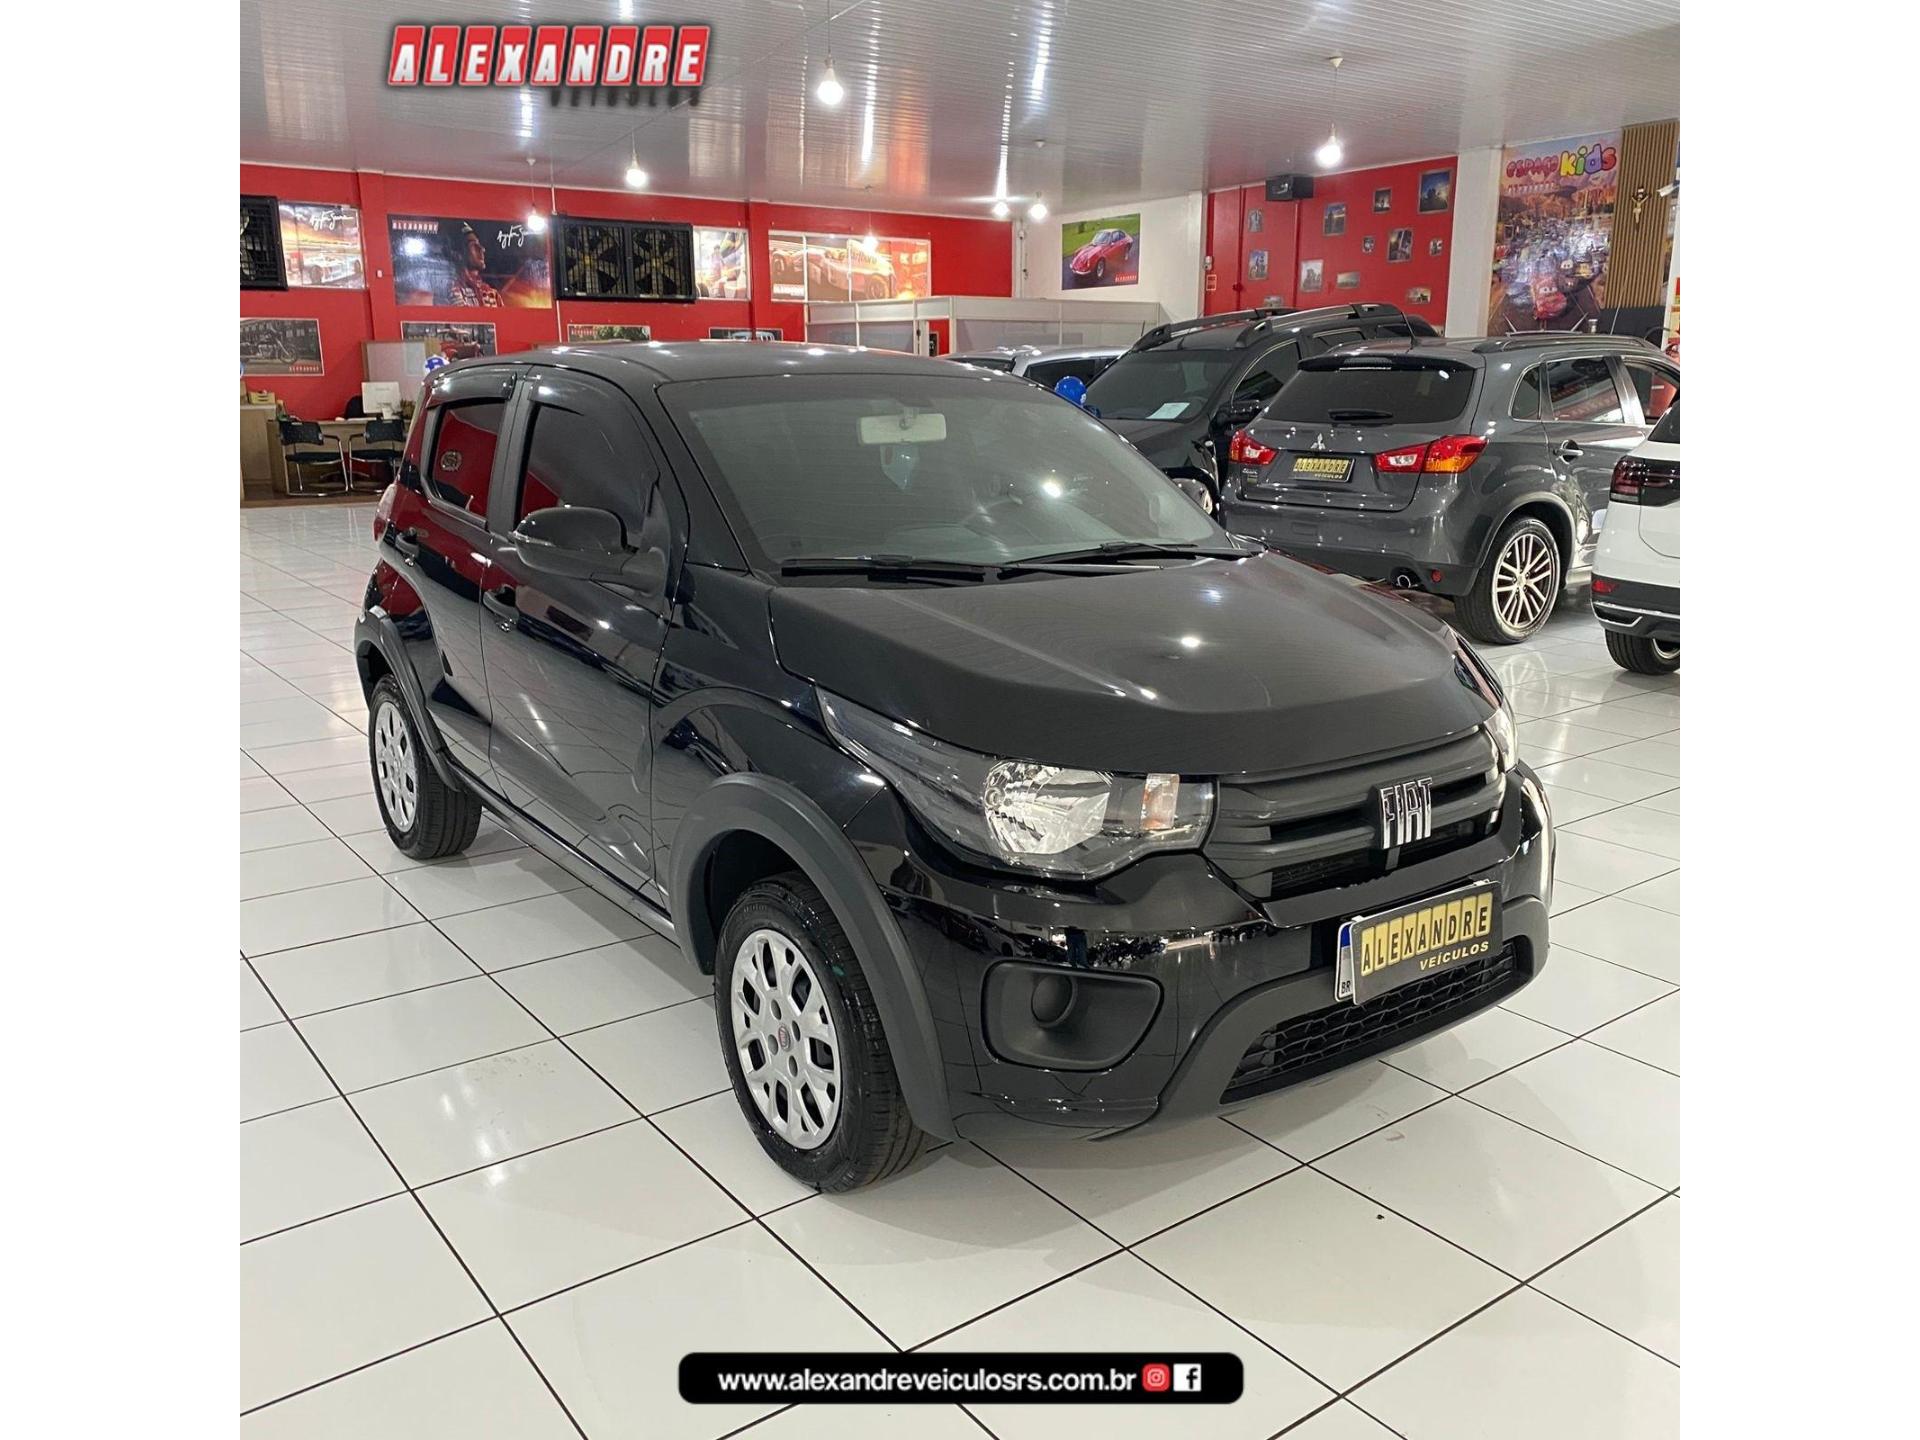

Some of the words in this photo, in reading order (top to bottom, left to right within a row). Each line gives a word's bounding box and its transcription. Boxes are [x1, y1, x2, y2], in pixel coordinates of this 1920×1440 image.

[1380, 777, 1432, 849] FIAT
[1362, 904, 1489, 974] ALEXANDRE
[1419, 941, 1490, 971] VEÍCULOS
[1341, 980, 1351, 994] BR
